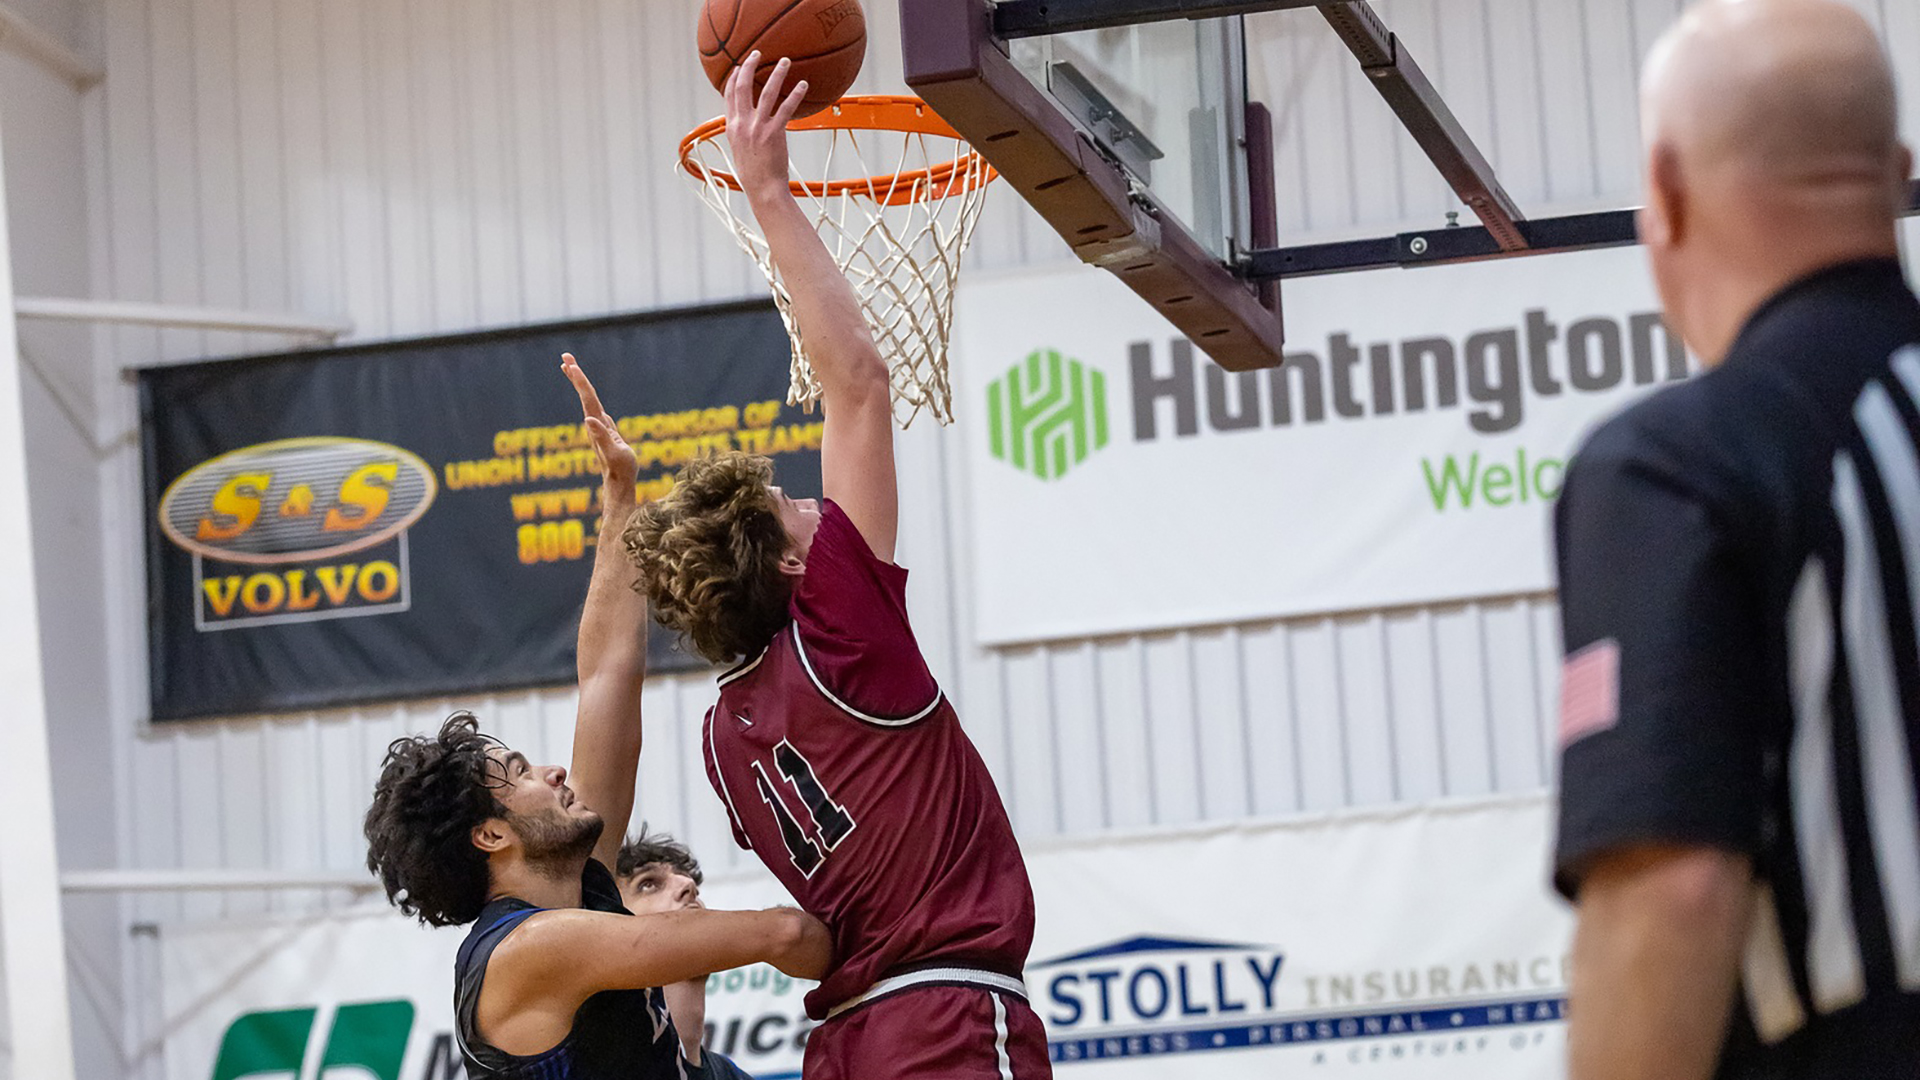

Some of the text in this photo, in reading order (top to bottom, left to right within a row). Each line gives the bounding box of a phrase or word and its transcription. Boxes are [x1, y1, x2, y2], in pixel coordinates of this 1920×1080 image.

[1129, 308, 1689, 441] Huntington
[744, 401, 781, 427] OF
[196, 462, 398, 540] S & S
[203, 560, 399, 616] VOLVO
[751, 735, 857, 881] 11
[1048, 955, 1284, 1027] STOLLY
[1248, 1012, 1428, 1045] PERSONAL
[1486, 1000, 1569, 1024] HEA
